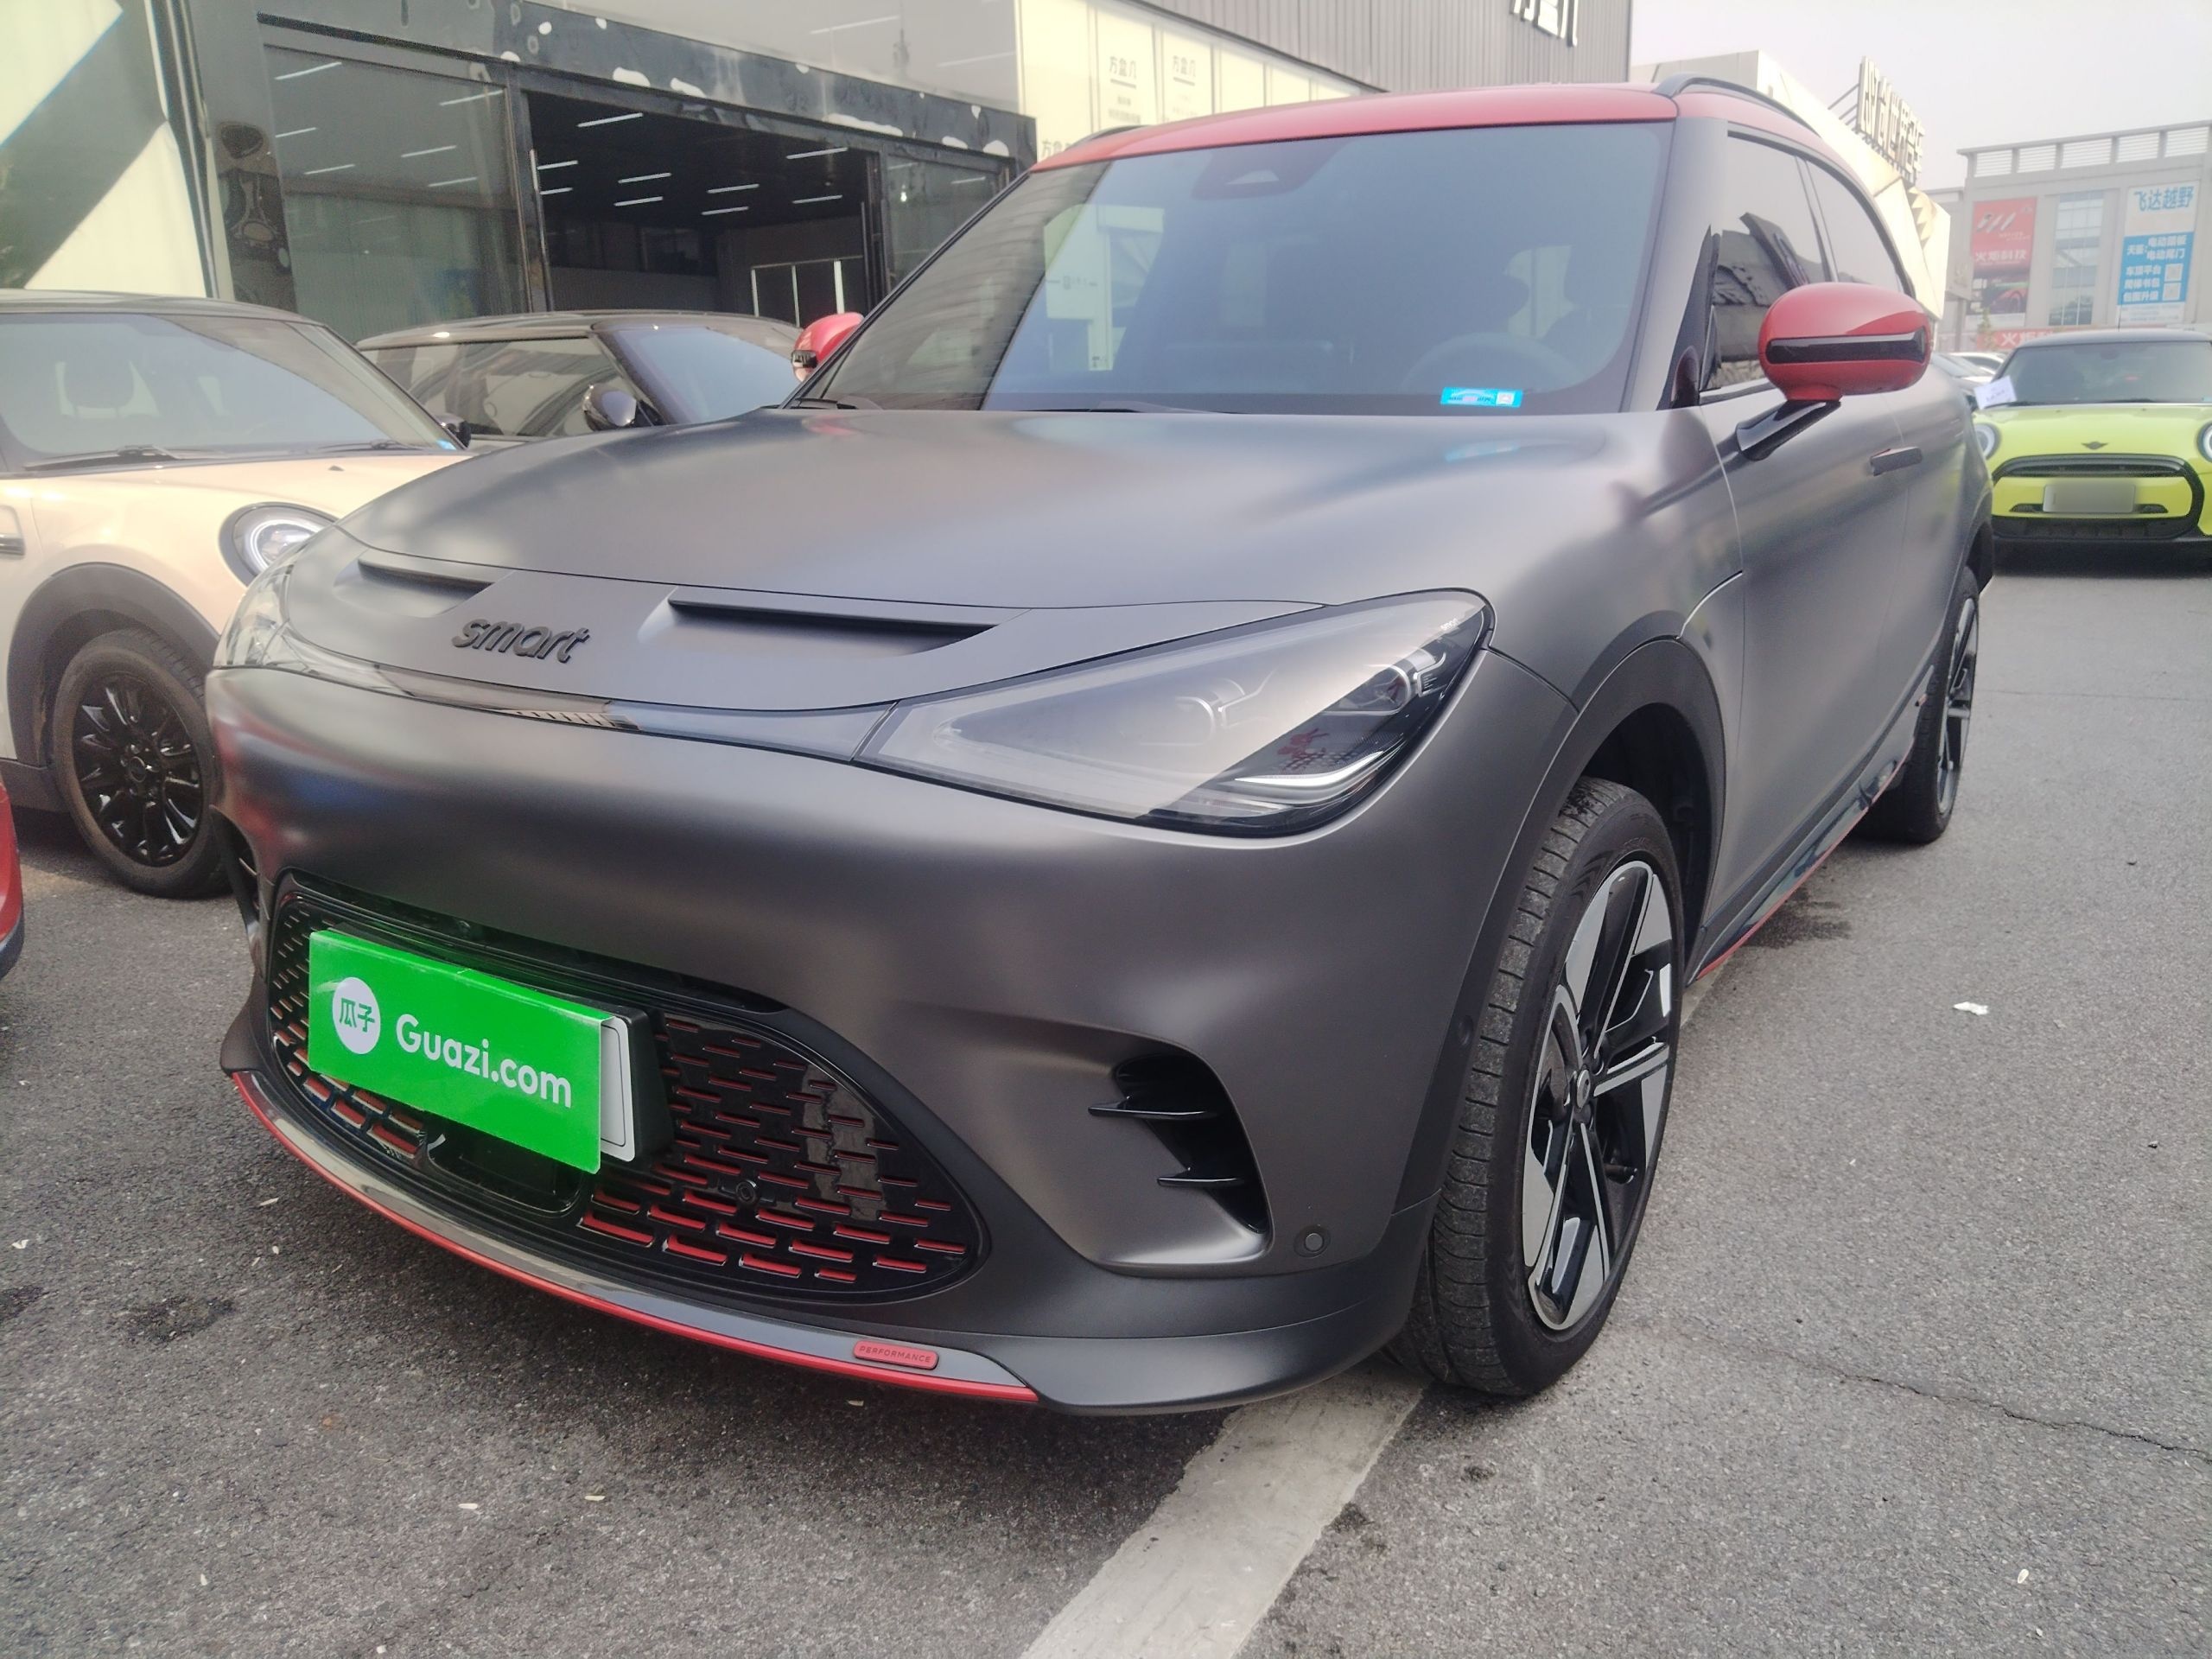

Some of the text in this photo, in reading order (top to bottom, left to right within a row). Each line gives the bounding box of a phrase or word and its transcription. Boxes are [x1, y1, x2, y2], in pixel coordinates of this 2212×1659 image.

[2133, 186, 2195, 212] 飞达越野
[452, 619, 590, 664] smart
[339, 997, 375, 1033] 瓜子
[395, 1013, 572, 1109] Guazi.com
[859, 1345, 931, 1363] PERFORMANCE
